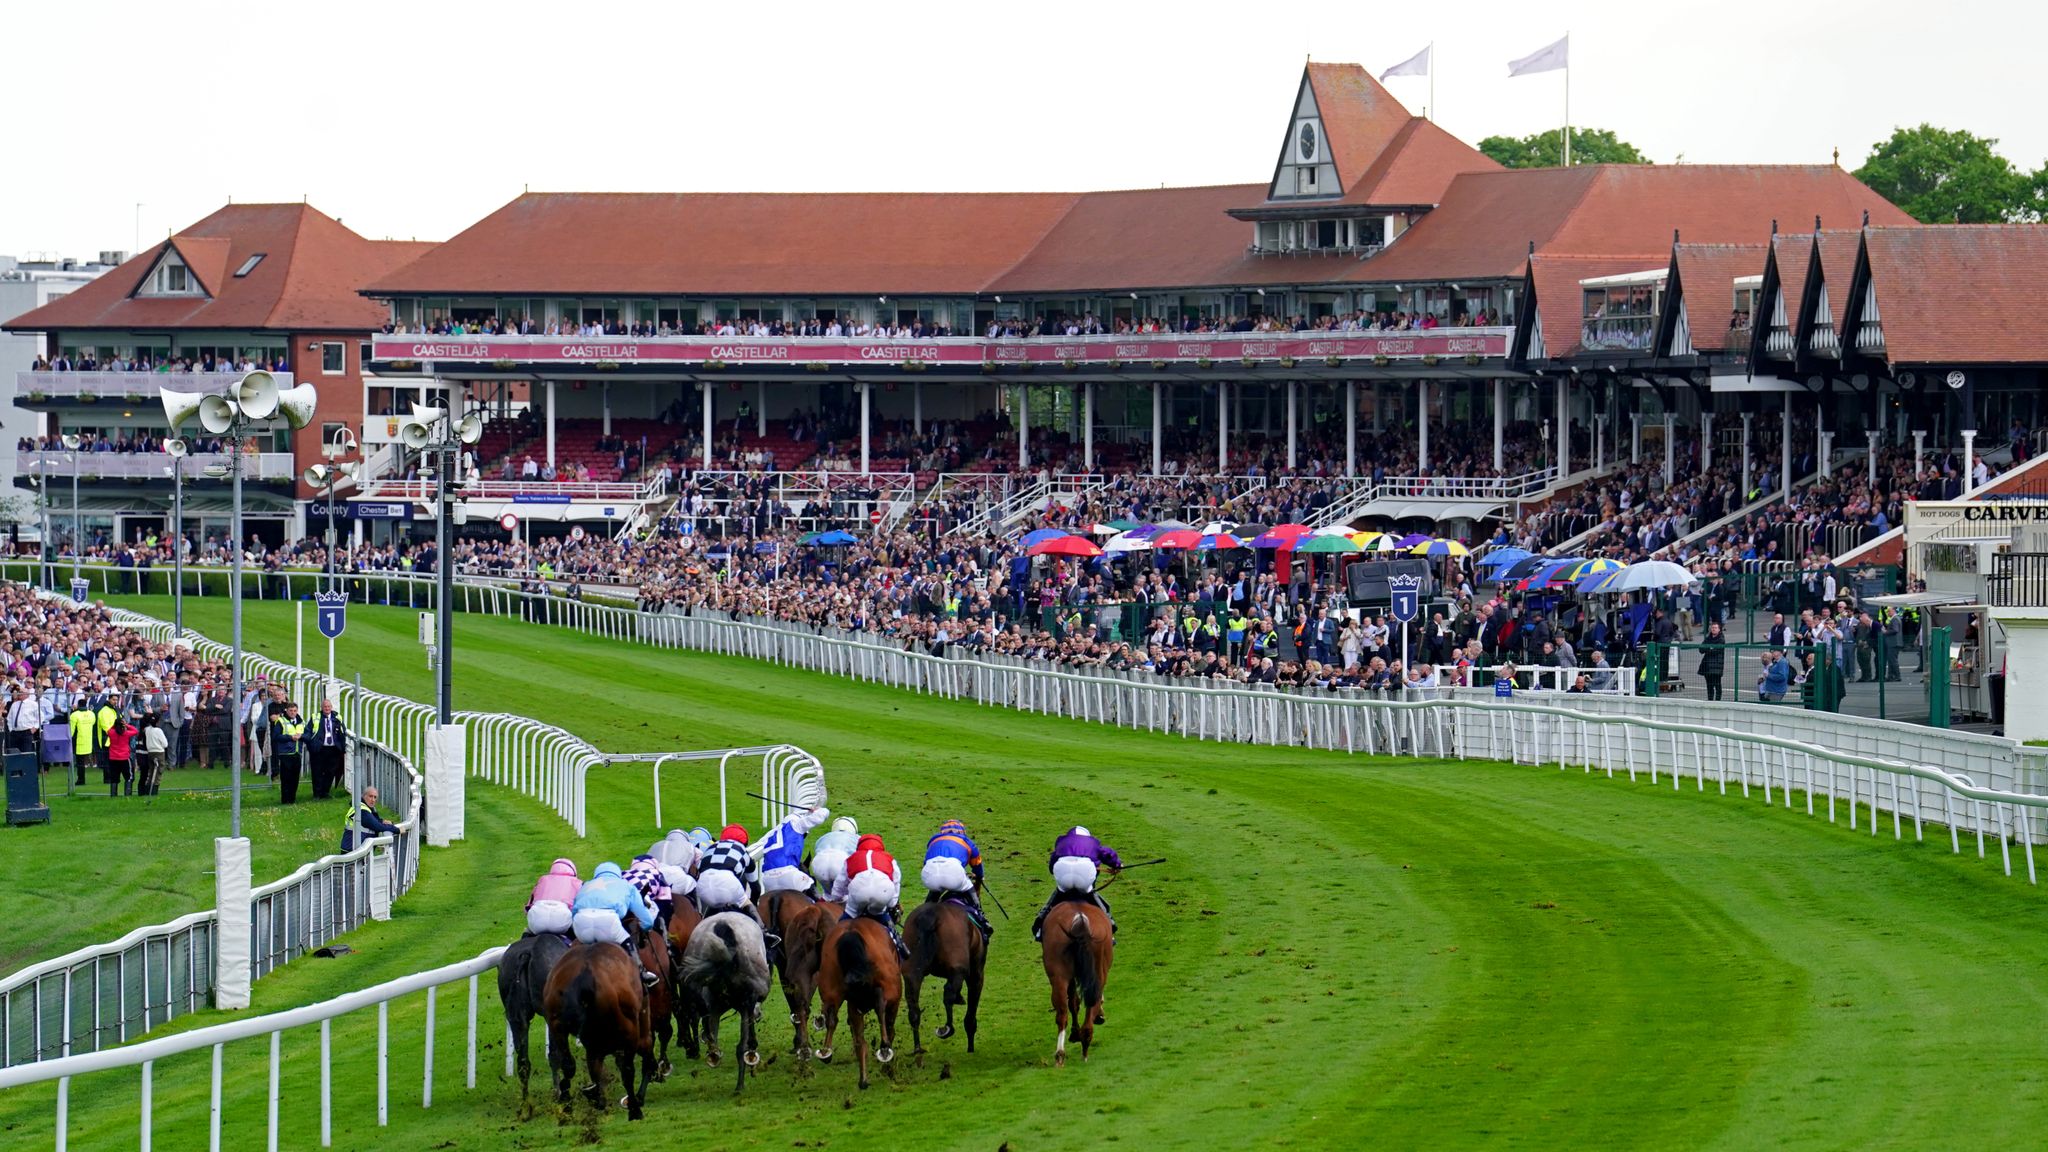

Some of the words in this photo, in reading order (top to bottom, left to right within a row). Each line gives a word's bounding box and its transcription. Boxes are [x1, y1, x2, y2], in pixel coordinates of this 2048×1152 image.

[412, 344, 488, 357] CAASTELLAR
[561, 345, 638, 357] CAASTELLAR
[711, 346, 788, 358] CAASTELLAR
[861, 347, 938, 359] CAASTELLAR
[360, 506, 388, 514] Chester
[1400, 597, 1408, 614] 1
[326, 612, 335, 630] 1
